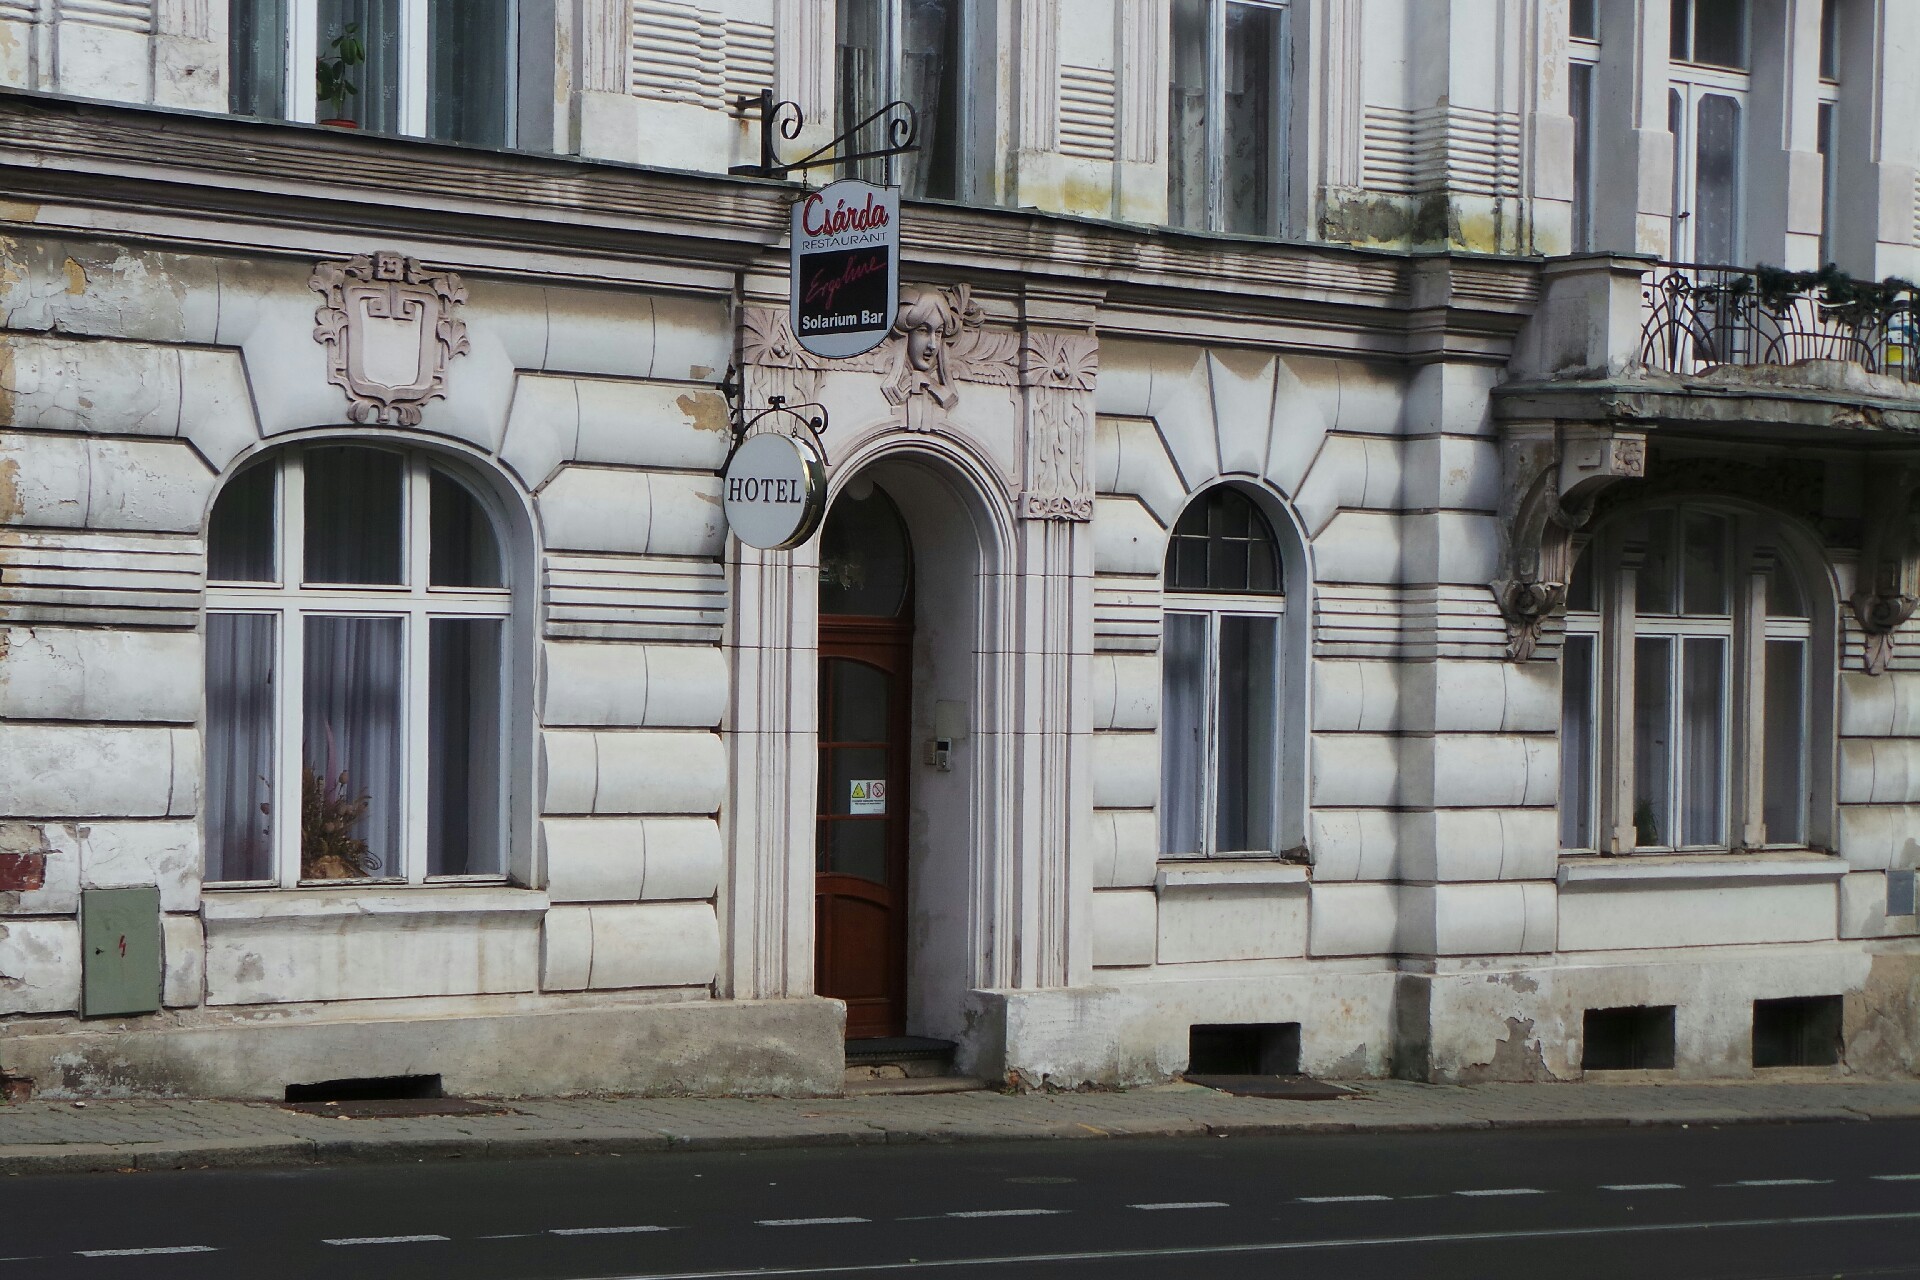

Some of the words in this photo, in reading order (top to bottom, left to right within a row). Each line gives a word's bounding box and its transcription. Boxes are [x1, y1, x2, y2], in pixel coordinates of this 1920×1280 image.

[803, 192, 889, 237] Csárda
[802, 232, 887, 250] RESTAURANT
[802, 312, 857, 330] Solarium
[861, 310, 884, 325] Bar
[728, 477, 801, 503] HOTEL
